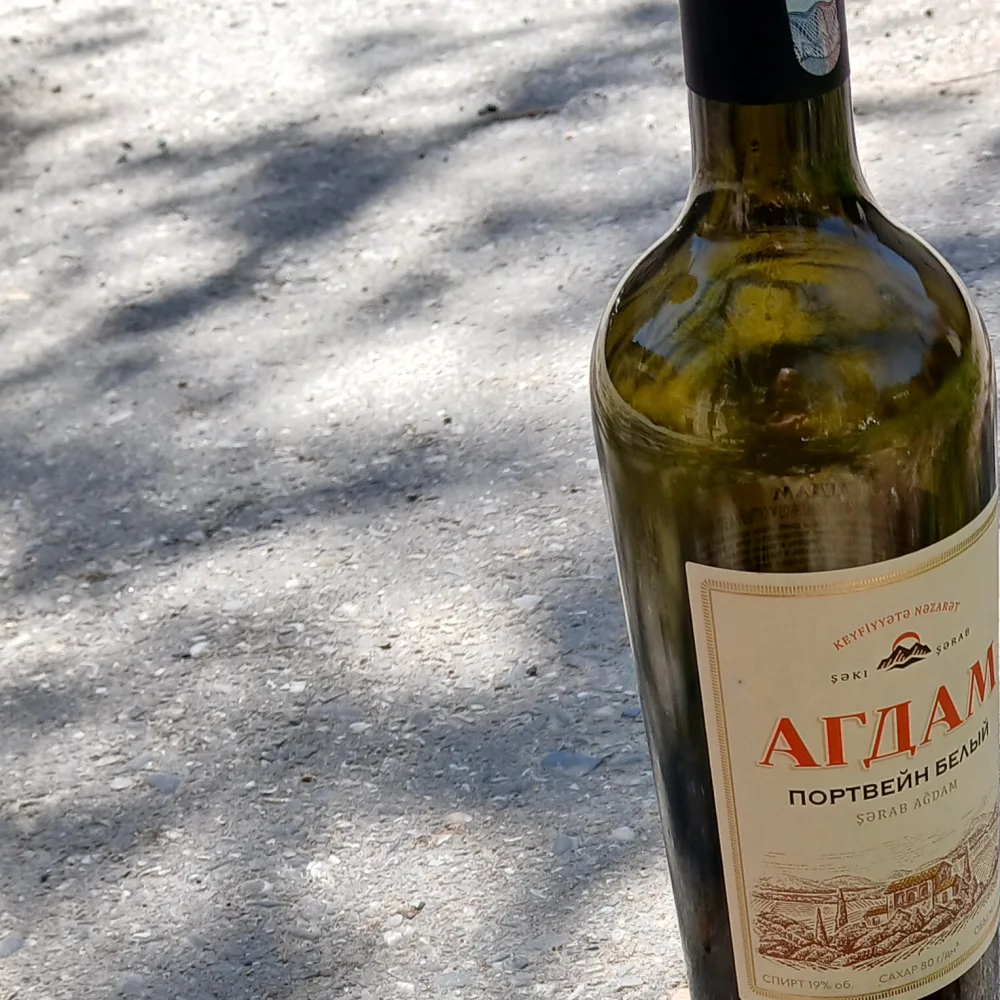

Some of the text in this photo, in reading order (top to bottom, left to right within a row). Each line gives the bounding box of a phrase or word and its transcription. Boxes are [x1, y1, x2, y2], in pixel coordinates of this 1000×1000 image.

[914, 601, 960, 616] NƏZARƏT
[935, 628, 971, 654] ŞƏRAB
[758, 641, 997, 769] АГДАМ
[788, 719, 990, 806] ПОРТВЕЙН БЕЛЫЙ
[856, 779, 959, 827] ŞƏRAB AĞDAM
[762, 974, 805, 988] СПИРТ
[808, 980, 831, 990] 19%
[878, 964, 918, 984] САХАР
[920, 958, 935, 971] 80
